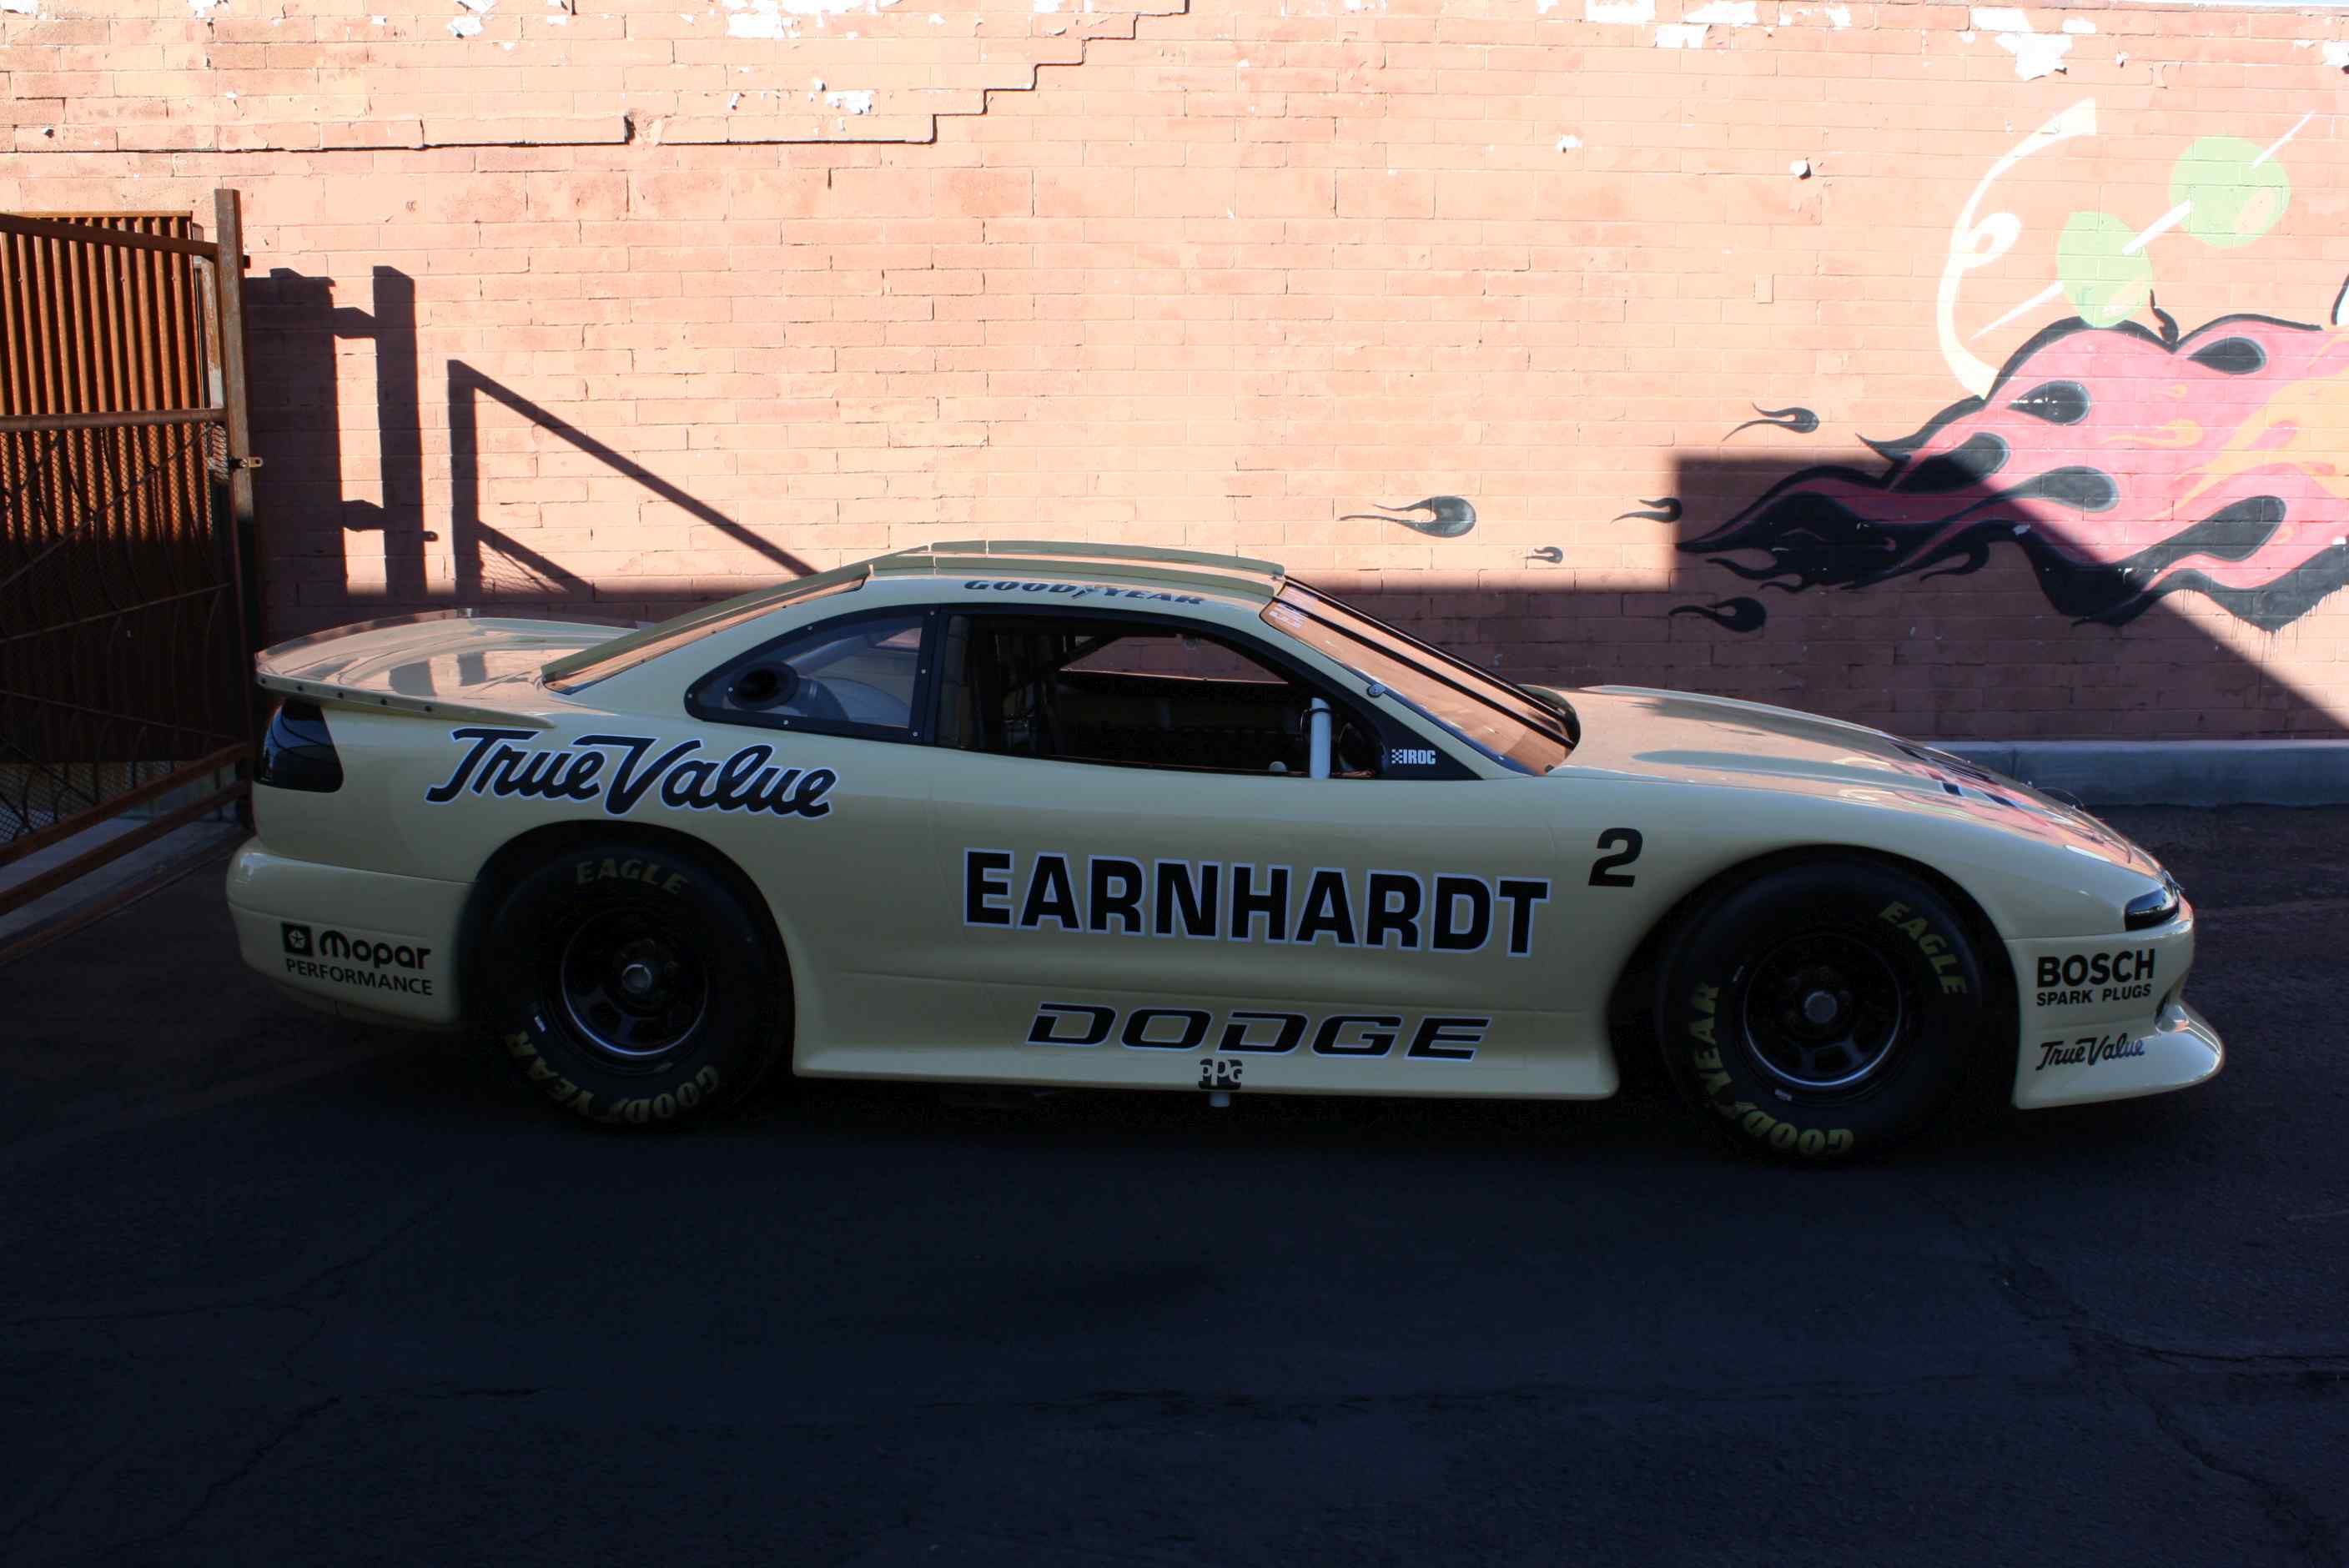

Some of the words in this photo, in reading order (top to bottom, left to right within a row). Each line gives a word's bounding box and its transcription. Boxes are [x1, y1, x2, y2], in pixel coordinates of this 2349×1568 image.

[1403, 749, 1436, 765] IROC
[575, 857, 687, 895] EAGLE
[1587, 827, 1643, 887] 2
[963, 847, 1552, 959] EARNHARDT
[1877, 900, 1968, 995] EAGLE
[285, 958, 433, 995] PERFORMANCE
[2037, 948, 2155, 988] BOSCH
[2036, 989, 2093, 1006] SPARK
[2102, 983, 2151, 1002] PLUGS
[1029, 1004, 1490, 1061] DODGE
[1199, 1058, 1243, 1089] PPG
